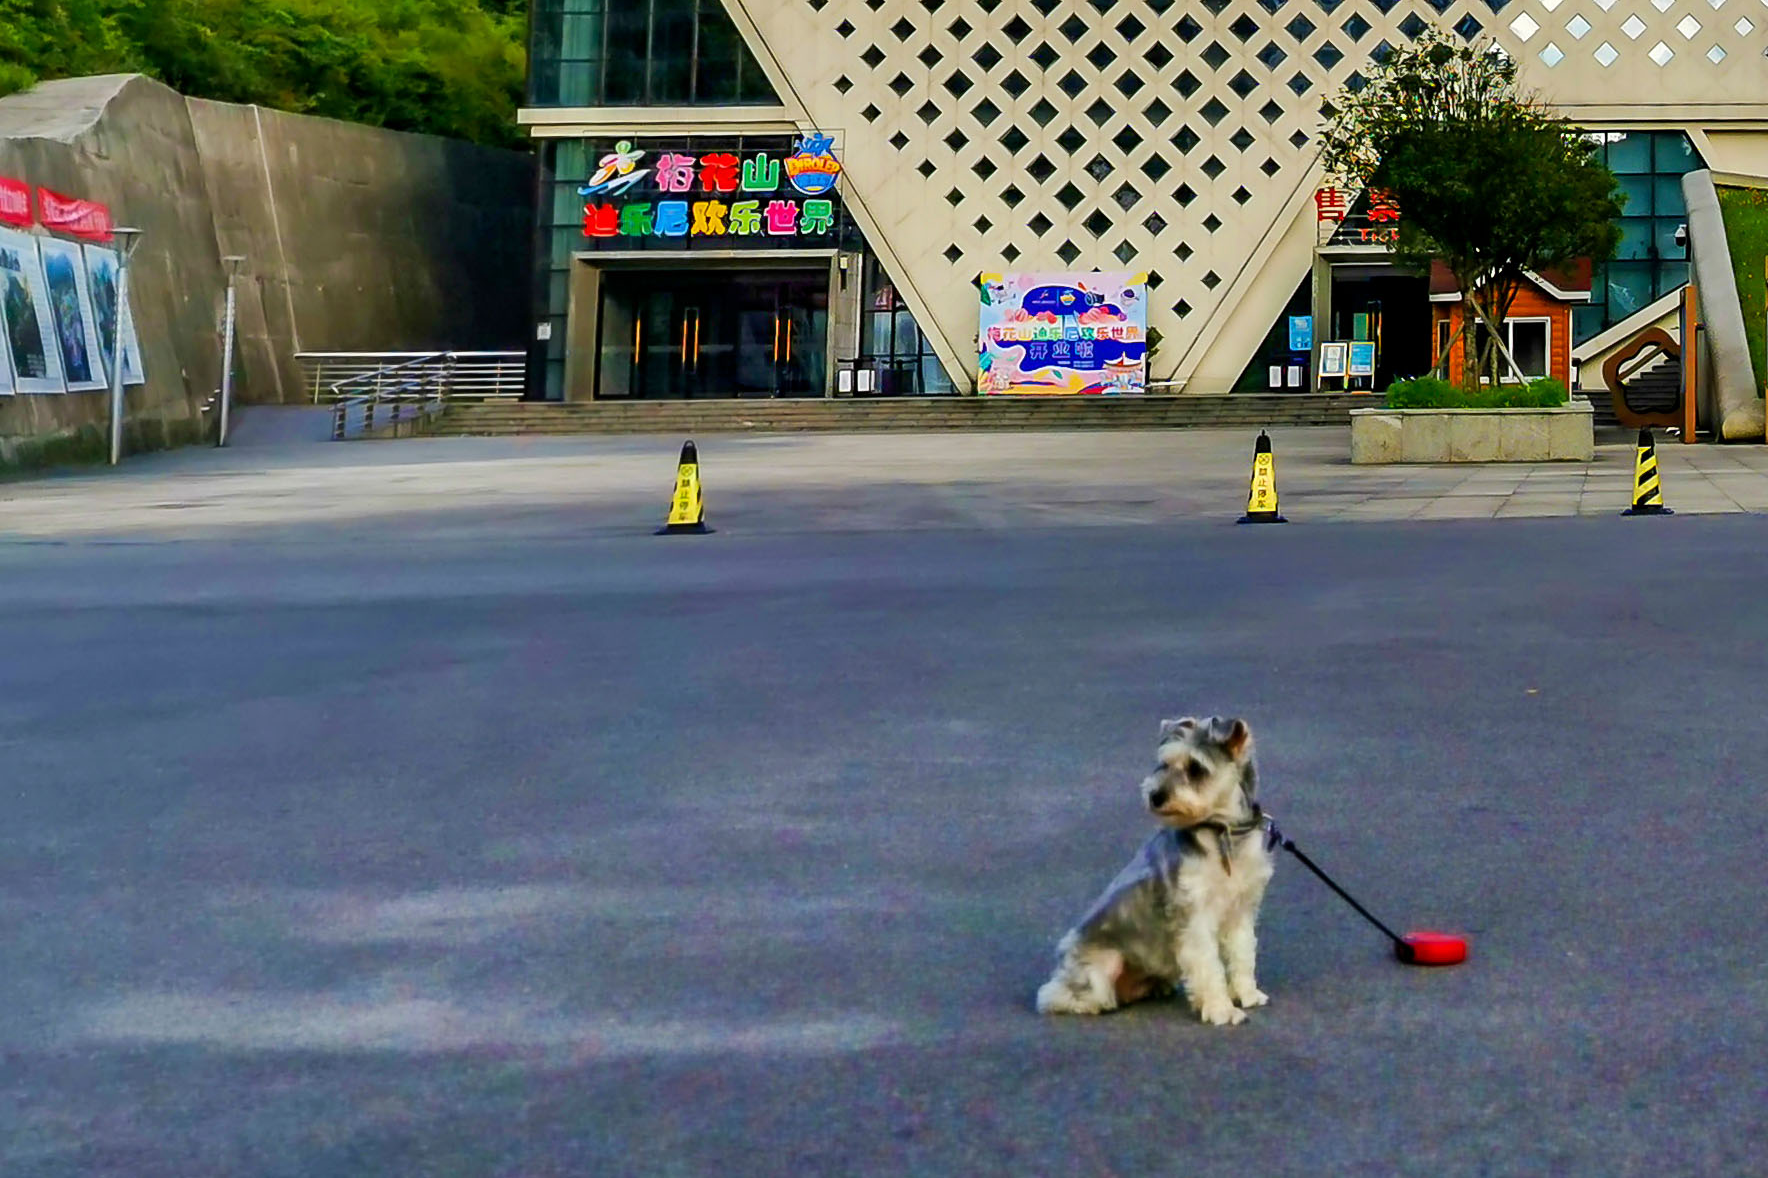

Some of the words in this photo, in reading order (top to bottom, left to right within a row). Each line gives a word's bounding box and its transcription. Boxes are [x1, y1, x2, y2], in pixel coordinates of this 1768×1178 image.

[656, 152, 780, 192] 梅花山
[583, 199, 834, 238] 迪乐尼欢乐世界
[1030, 340, 1094, 360] 开业啦
